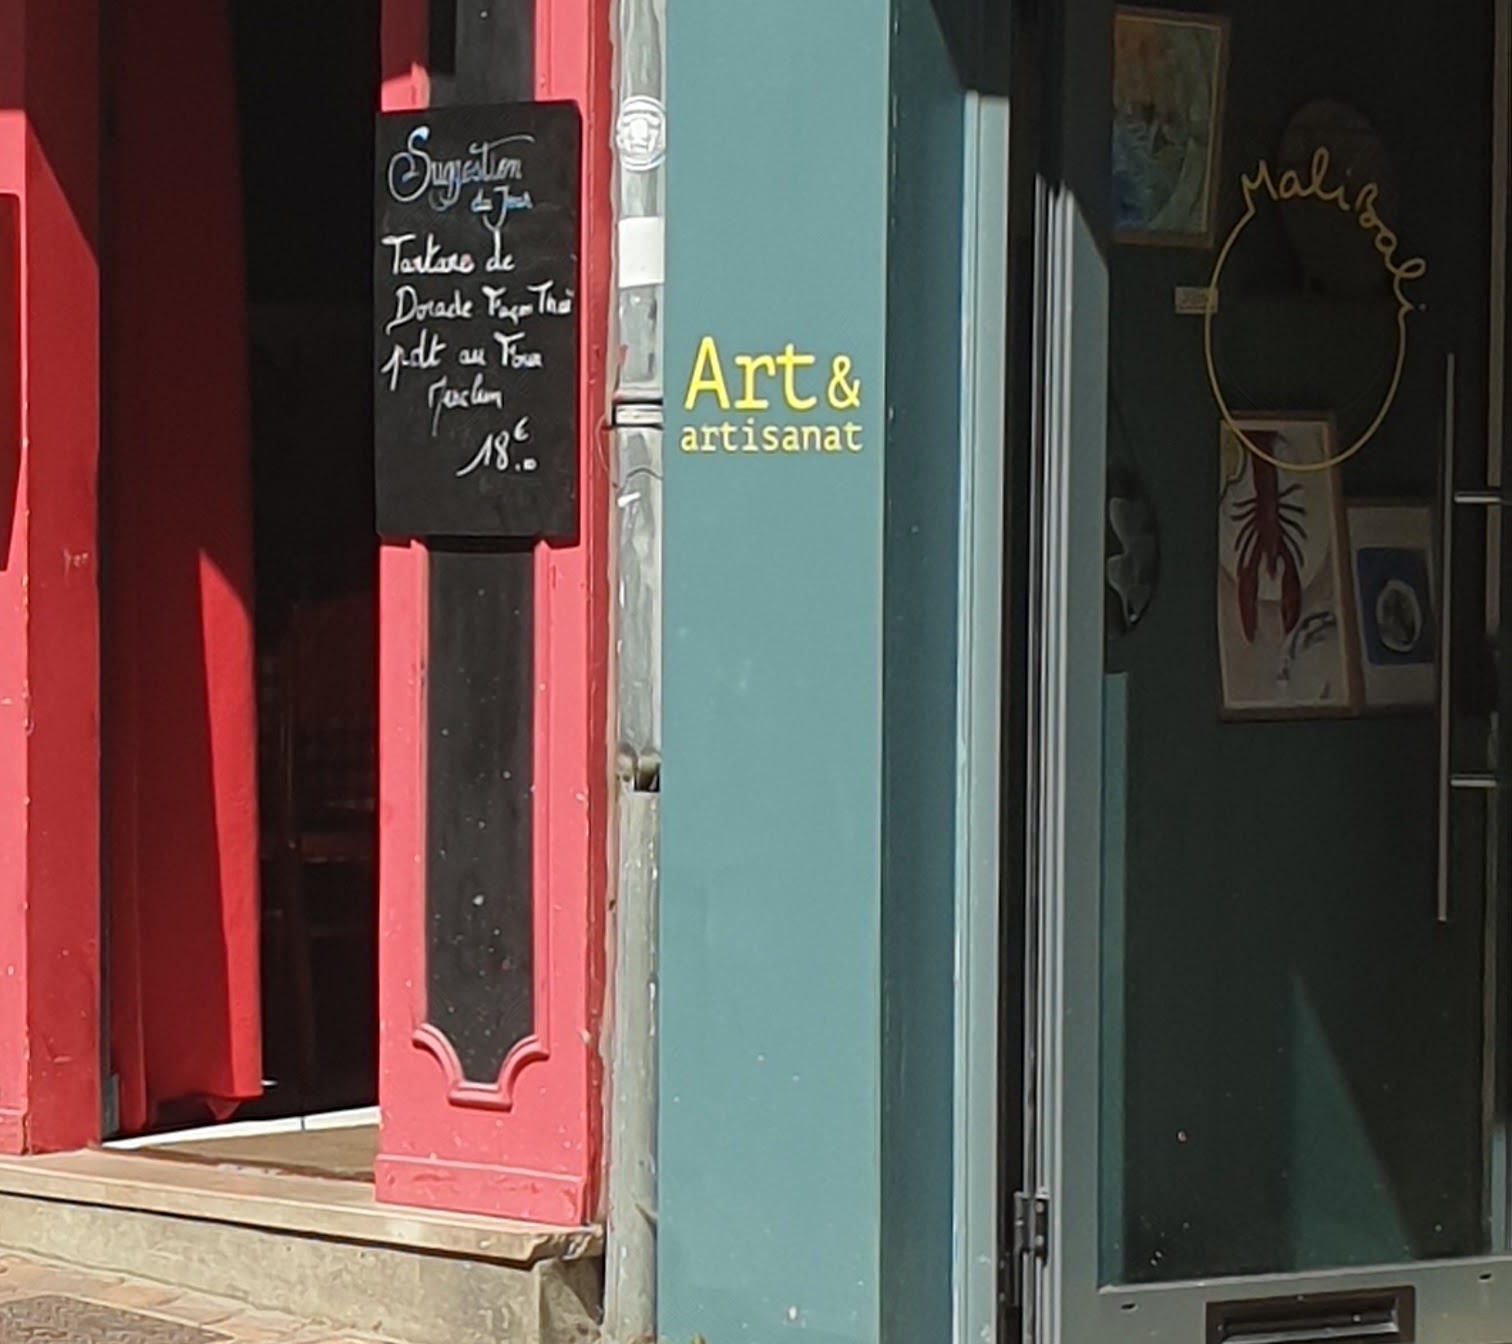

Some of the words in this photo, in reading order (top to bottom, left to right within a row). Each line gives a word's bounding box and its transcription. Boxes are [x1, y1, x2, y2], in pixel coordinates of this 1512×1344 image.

[381, 232, 476, 275] Tartare
[484, 228, 516, 272] de
[683, 335, 818, 411] Art
[827, 354, 862, 410] &
[679, 416, 865, 453] artisanat
